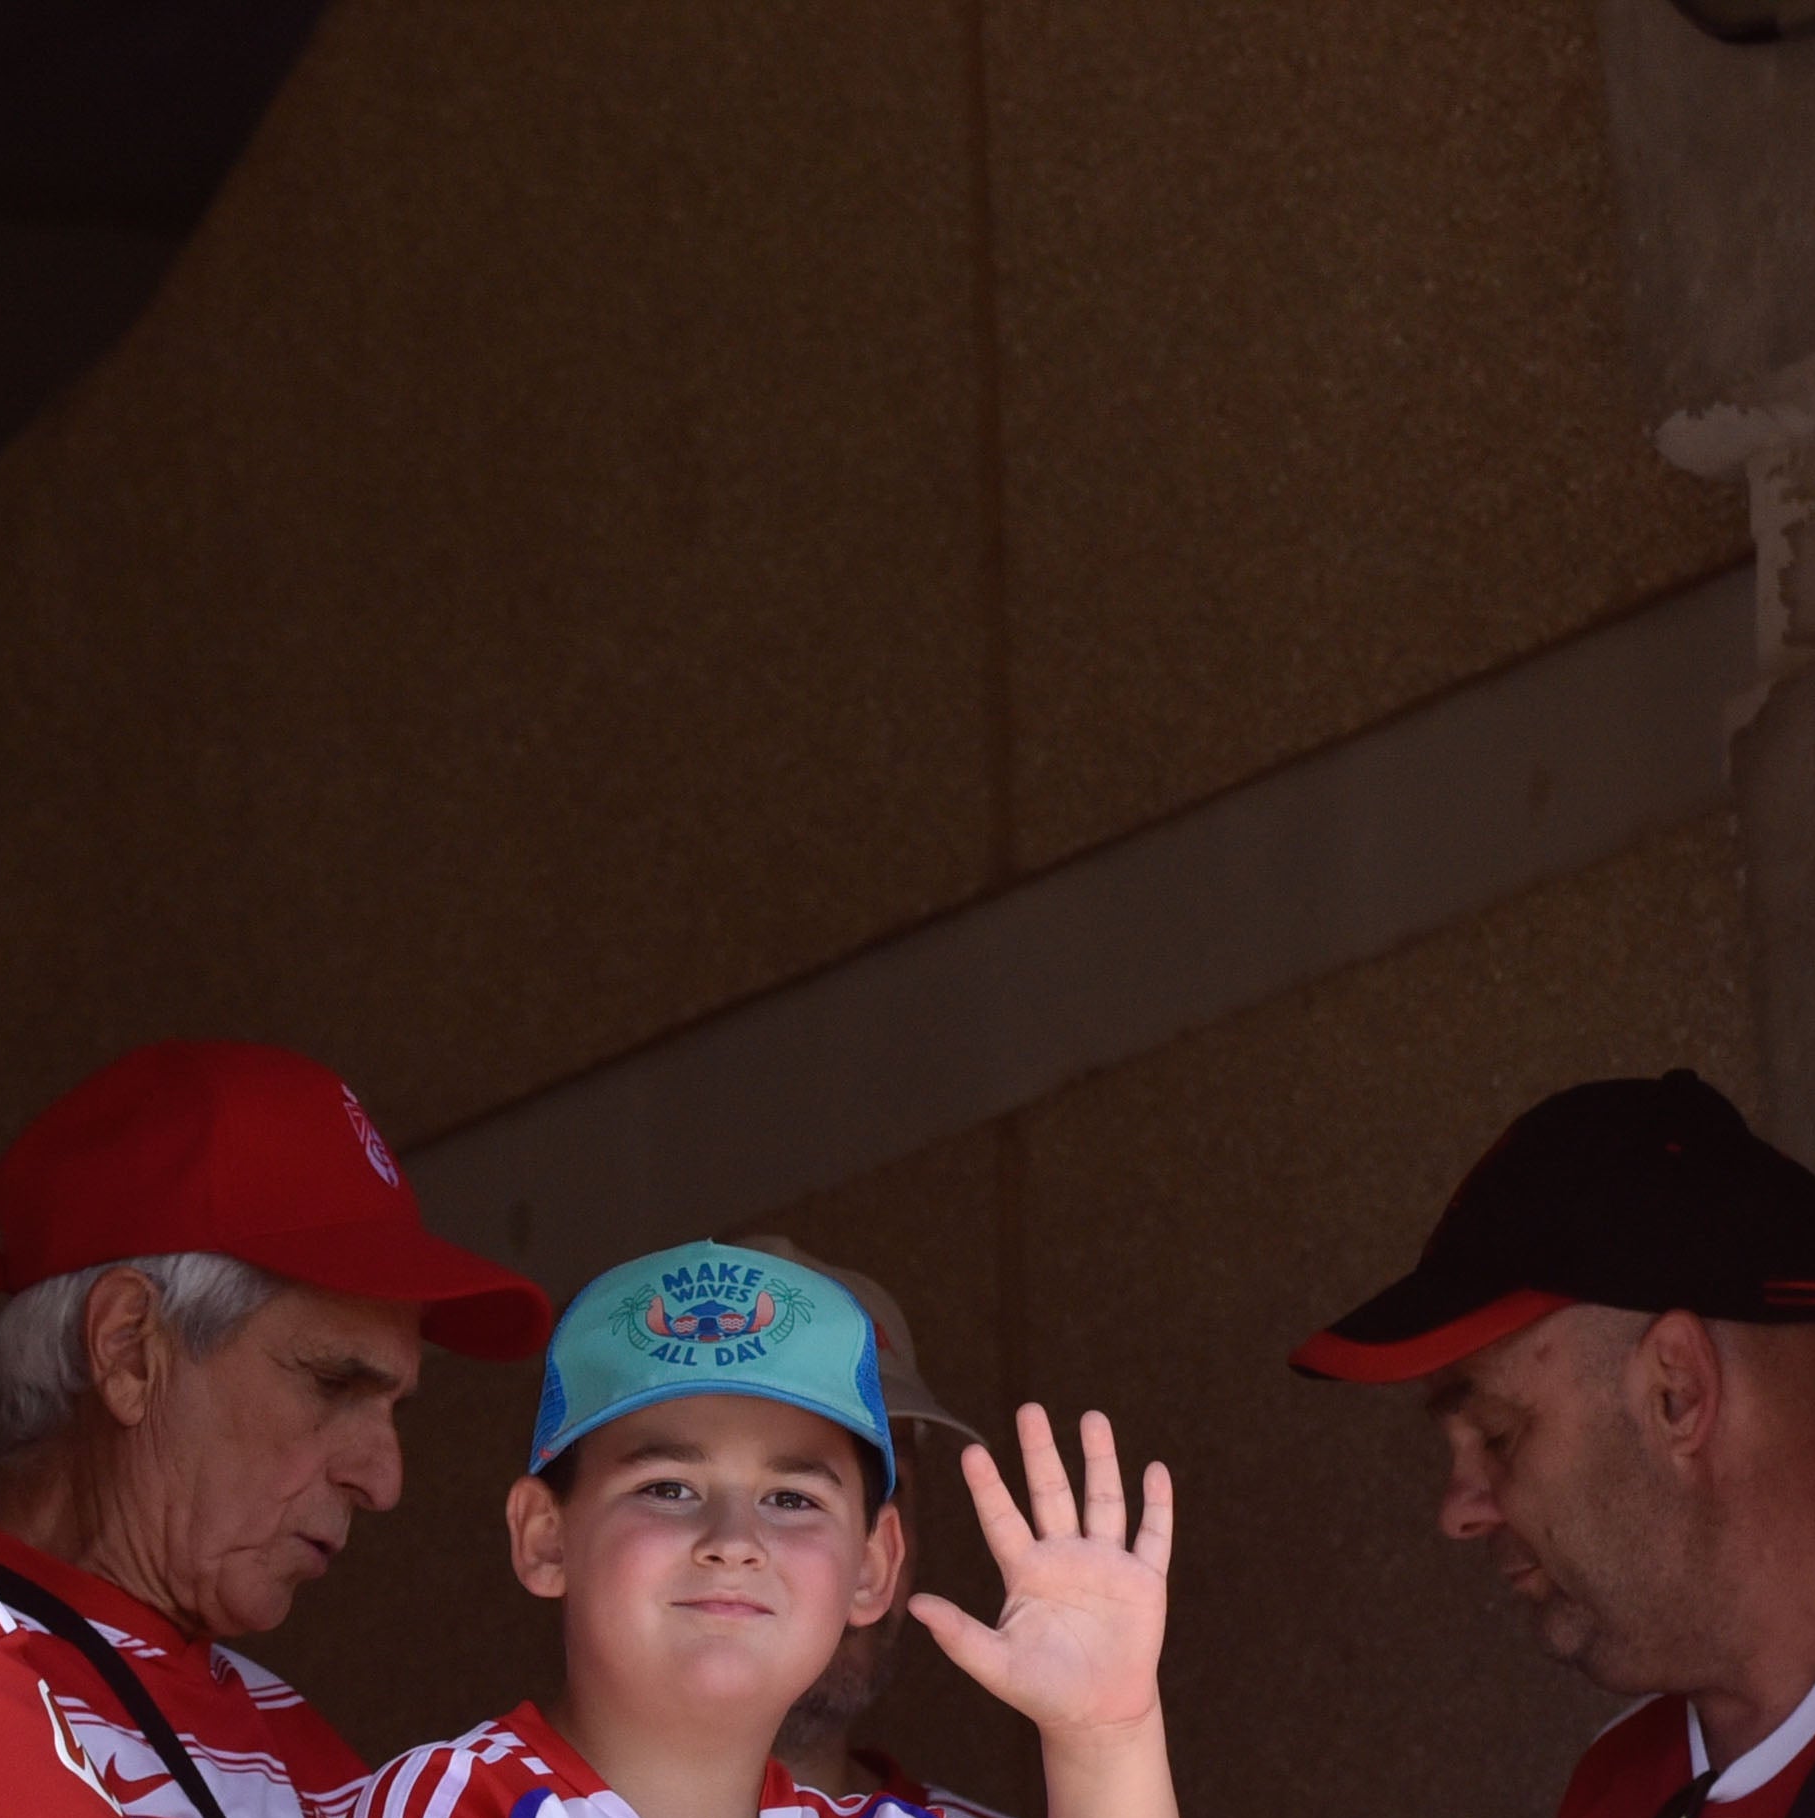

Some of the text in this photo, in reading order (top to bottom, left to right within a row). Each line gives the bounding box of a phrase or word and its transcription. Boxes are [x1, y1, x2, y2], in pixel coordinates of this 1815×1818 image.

[661, 1262, 765, 1293] MAKE
[671, 1284, 750, 1303] WAVES
[649, 1336, 768, 1367] ALL DAY
